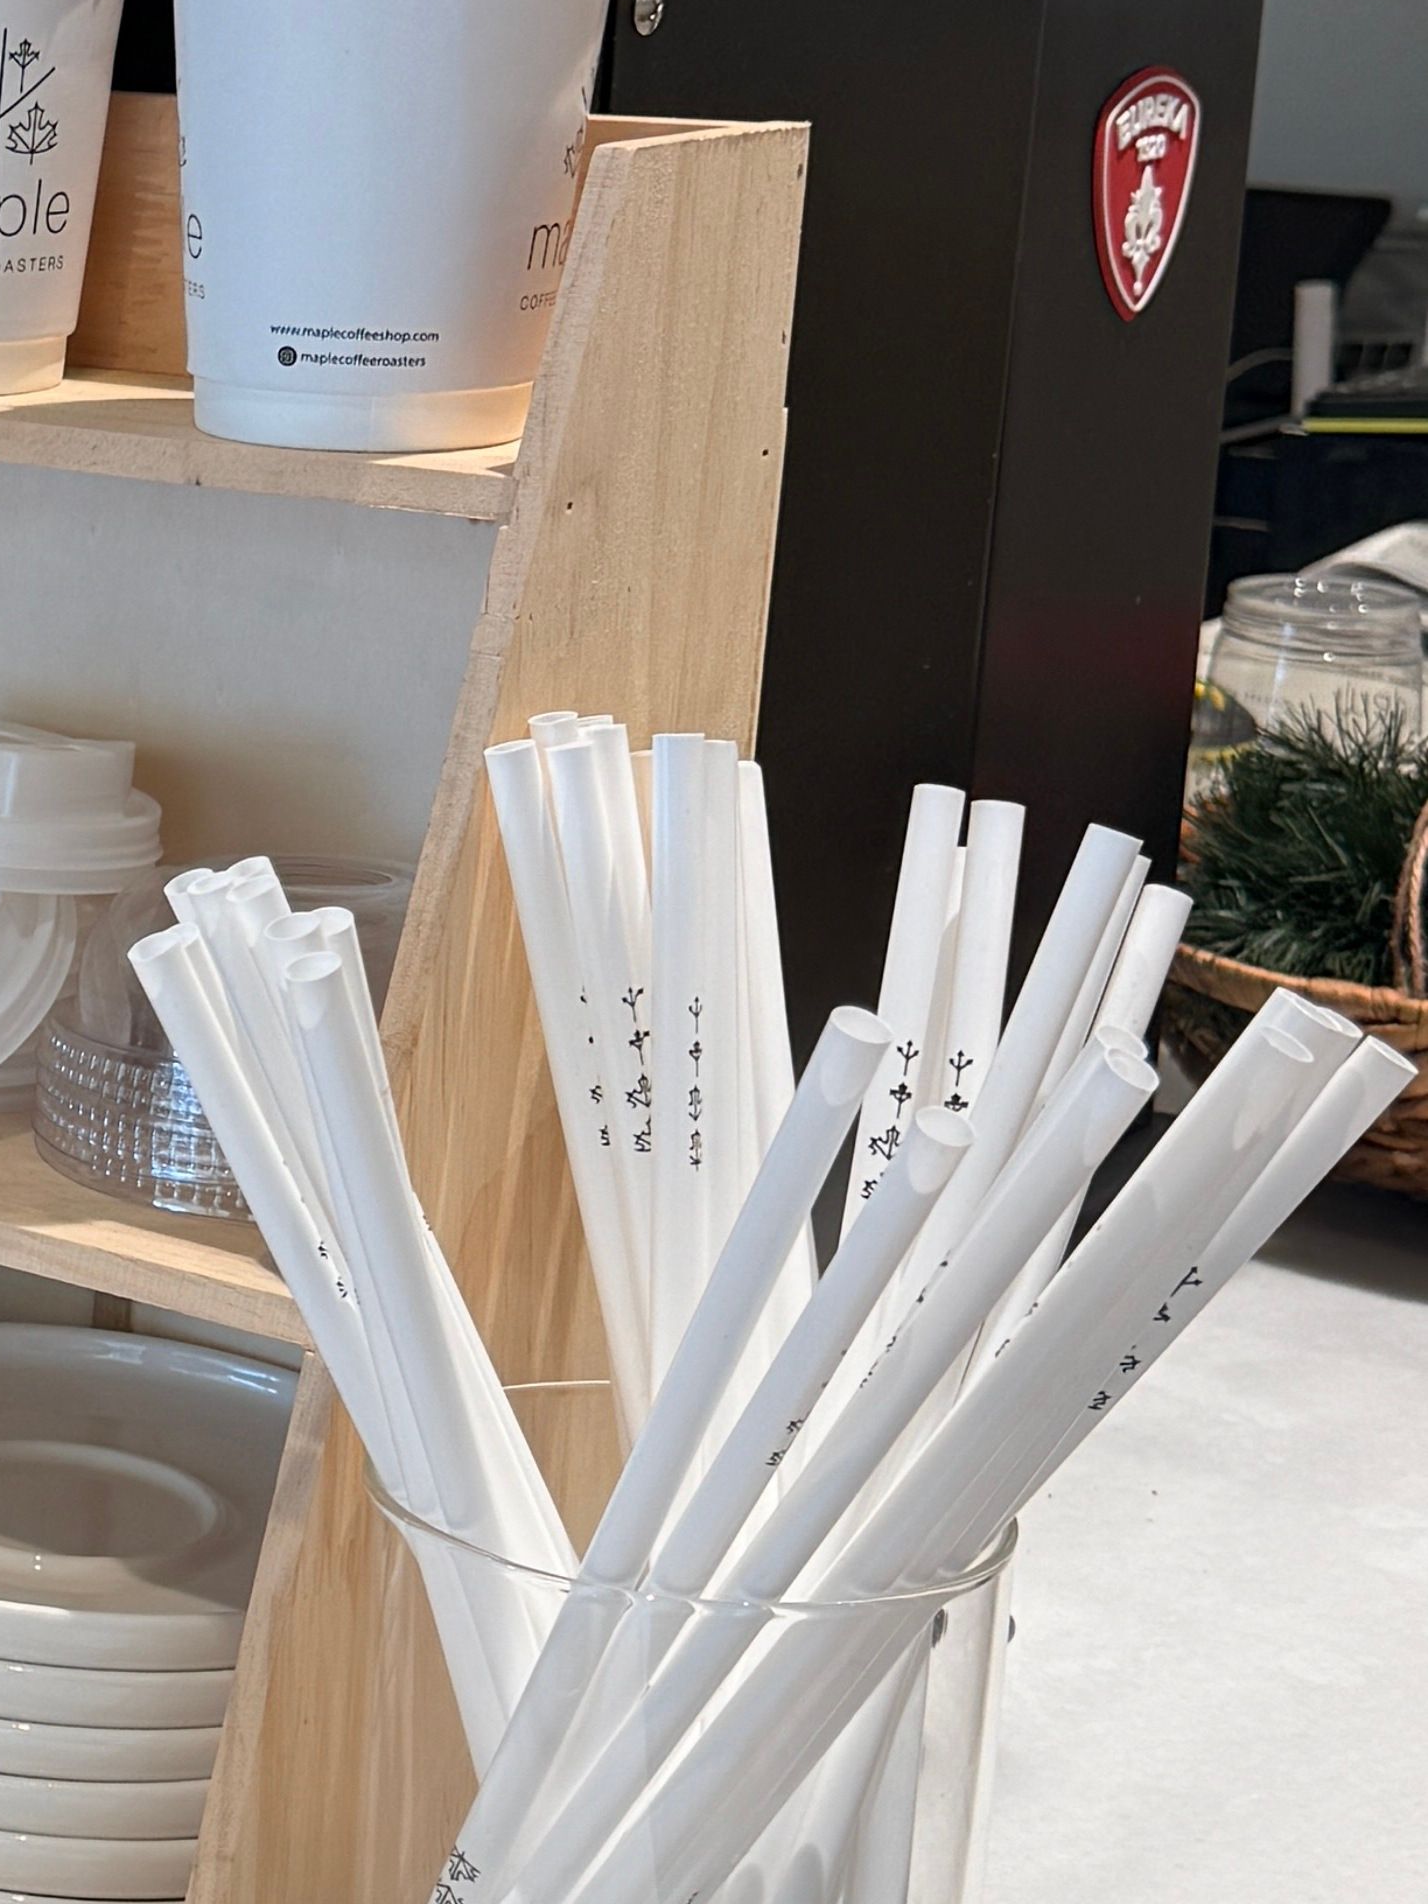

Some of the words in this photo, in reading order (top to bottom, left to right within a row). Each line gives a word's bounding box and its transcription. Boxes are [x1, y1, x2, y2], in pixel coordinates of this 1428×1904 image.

[1115, 93, 1189, 151] EUREKA
[269, 323, 441, 344] www.maplecoffeeshop.com
[300, 350, 427, 369] maplecoffeeroasters
